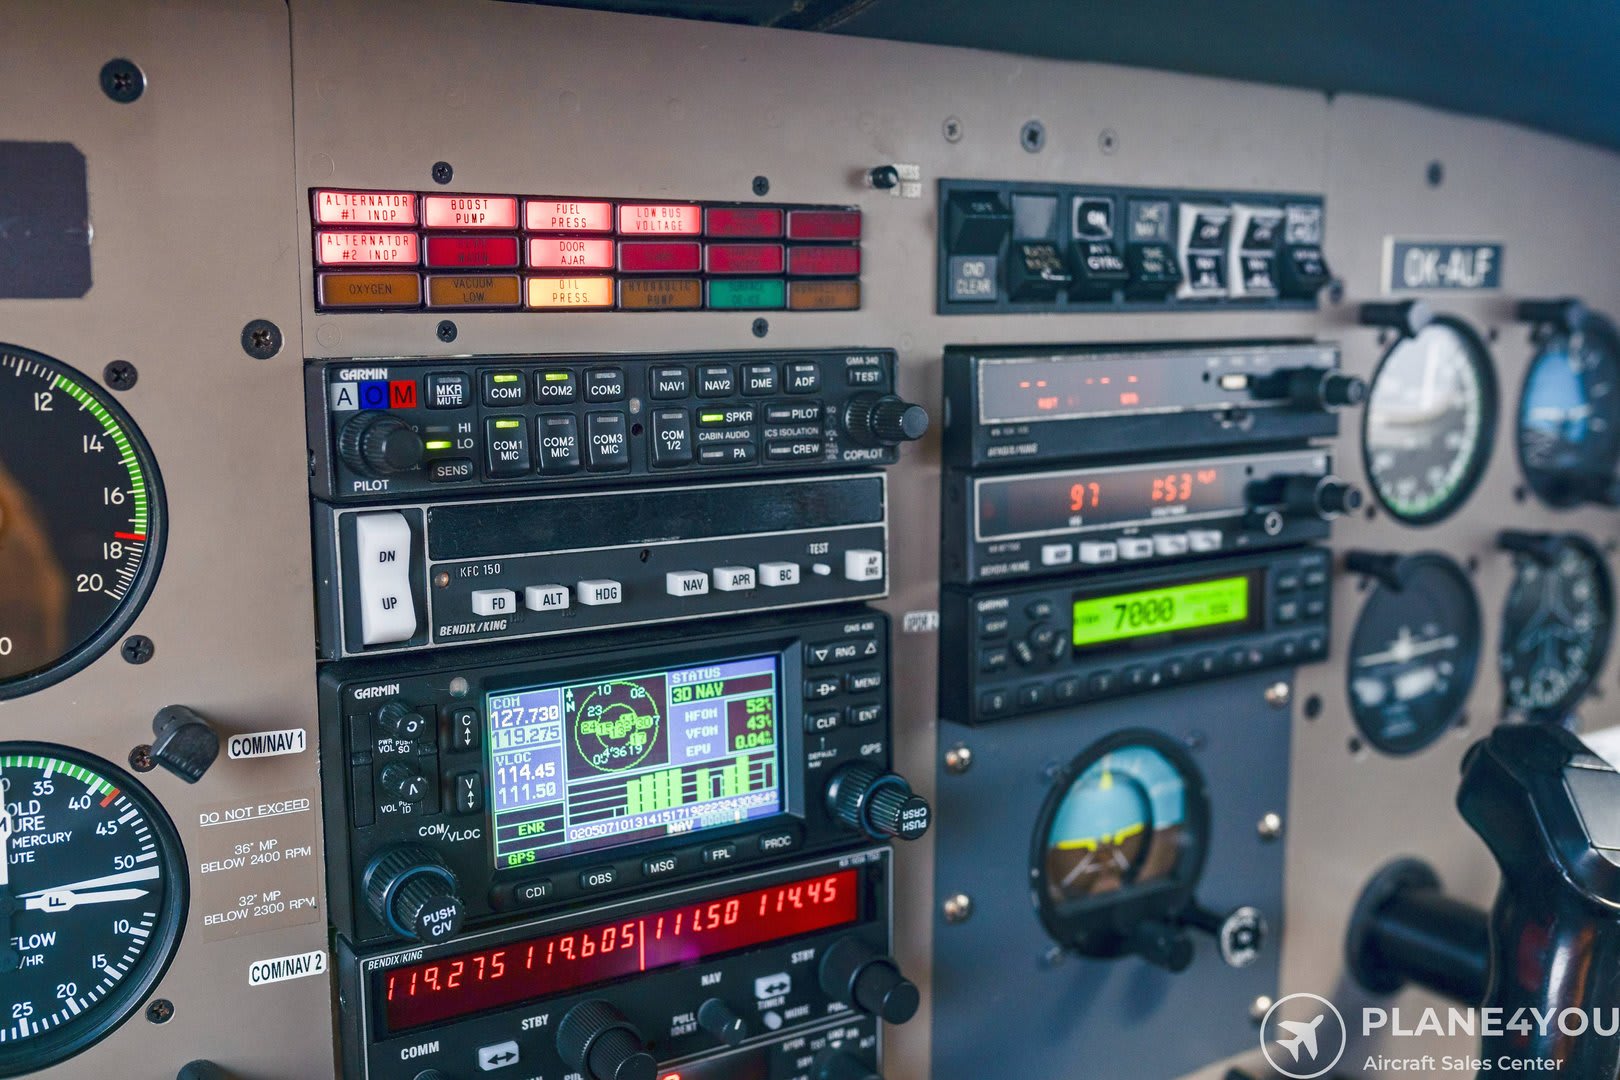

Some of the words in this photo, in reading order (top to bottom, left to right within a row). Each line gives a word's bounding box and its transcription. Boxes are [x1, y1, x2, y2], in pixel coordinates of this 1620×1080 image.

[326, 194, 408, 206] ALTERNATOR
[451, 199, 488, 210] BOOST
[341, 209, 356, 220] #1
[369, 210, 396, 221] INOP
[556, 204, 580, 214] FUEL
[637, 208, 657, 218] LOW
[662, 208, 681, 218] BUS
[456, 213, 485, 224] PUMP
[551, 216, 587, 228] PRESS
[636, 220, 683, 231] VOLTAGE
[327, 235, 409, 246] ALTERNATOR
[559, 241, 585, 252] DOOR
[342, 249, 357, 260] #2
[369, 250, 397, 260] INOP
[560, 254, 586, 265] AJAR
[349, 283, 392, 295] OXYGEN
[452, 278, 494, 289] VACUUM
[559, 279, 579, 290] OIL
[463, 291, 485, 303] LOW
[846, 356, 864, 365] GMA
[865, 355, 879, 364] 340
[339, 368, 388, 381] GARMIN
[854, 371, 879, 382] TEST
[659, 381, 685, 391] NAV1
[704, 380, 730, 391] NAV2
[751, 378, 773, 389] DME
[794, 376, 815, 386] ADF
[395, 385, 412, 404] M
[436, 384, 462, 395] MKR
[491, 387, 522, 399] COM1
[542, 385, 573, 396] COM2
[591, 384, 621, 396] COM3
[34, 392, 53, 411] 12
[436, 396, 462, 406] MUTE
[725, 411, 752, 423] SPKR
[791, 408, 819, 420] PILOT
[458, 423, 472, 433] HI
[779, 426, 819, 437] ISOLATION
[593, 435, 623, 445] COM3
[661, 430, 684, 440] COM
[698, 431, 724, 440] CABIN
[725, 429, 750, 439] AUDIO
[83, 435, 105, 454] 14
[457, 438, 474, 449] LO
[493, 441, 524, 451] COM1
[543, 437, 574, 447] COM2
[666, 440, 681, 451] 1/2
[550, 448, 570, 458] MIC
[600, 445, 619, 455] MIC
[732, 448, 746, 458] PA
[792, 443, 820, 454] CREW
[843, 448, 884, 460] COPILOT
[500, 450, 519, 461] MIC
[437, 465, 468, 477] SENS
[353, 480, 390, 492] PILOT
[104, 487, 125, 505] 16
[1070, 482, 1100, 512] 97
[103, 541, 123, 560] 18
[810, 543, 829, 554] TEST
[379, 550, 396, 562] DN
[460, 566, 479, 577] KFC
[483, 564, 501, 575] 150
[780, 570, 792, 581] BC
[76, 573, 104, 593] 20
[683, 579, 704, 592] NAV
[732, 574, 751, 586] APR
[543, 592, 563, 605] ALT
[595, 588, 618, 600] HDG
[382, 598, 397, 610] UP
[492, 598, 506, 610] FD
[1113, 597, 1174, 631] 7000
[439, 620, 507, 636] BENDIX/KING
[835, 646, 856, 658] RNG
[672, 667, 721, 684] STATUS
[854, 677, 881, 689] MENU
[354, 684, 400, 700] GARMIN
[672, 686, 692, 702] 3D
[696, 682, 724, 700] NAV
[462, 716, 471, 726] C
[492, 704, 559, 728] 127.730
[858, 709, 878, 722] ENT
[816, 718, 837, 729] CLR
[231, 731, 294, 757] COM/NAV
[297, 731, 303, 749] 1
[378, 744, 394, 754] VOL
[686, 742, 712, 758] EPU
[860, 742, 882, 756] GPS
[496, 752, 532, 766] VLOC
[498, 762, 556, 785] 114.45
[32, 780, 55, 796] 35
[499, 782, 556, 805] 111.50
[68, 794, 92, 810] 40
[200, 812, 220, 825] DO
[225, 806, 253, 820] NOT
[258, 798, 310, 815] EXCEED
[380, 804, 398, 814] VOL
[95, 820, 118, 836] 45
[418, 823, 481, 842] COM/VLOC
[518, 822, 546, 836] ENR
[12, 830, 73, 849] MERCURY
[260, 839, 278, 852] MP
[764, 835, 792, 850] PROC
[201, 856, 246, 874] BELOW
[250, 850, 281, 866] 2400
[285, 846, 312, 860] RPM
[508, 850, 536, 866] GPS
[712, 850, 731, 860] FPL
[114, 855, 135, 870] 50
[650, 860, 675, 874] MSG
[588, 872, 612, 886] OBS
[262, 890, 281, 902] MP
[525, 886, 546, 899] CDI
[204, 909, 250, 926] BELOW
[254, 902, 285, 918] 2300
[289, 897, 316, 910] RPM
[654, 899, 738, 940] 111.50
[757, 878, 837, 917] 114.45
[422, 905, 457, 926] PUSH
[114, 919, 130, 934] 10
[432, 921, 453, 936] C/V
[92, 954, 108, 970] 15
[368, 950, 424, 971] BENDIX/KING
[387, 951, 506, 1001] 119.275
[526, 922, 634, 971] 119.605
[252, 956, 312, 983] COM/NAV
[314, 953, 322, 970] 2
[701, 972, 722, 987] NAV
[56, 982, 78, 999] 20
[12, 1001, 34, 1019] 25
[521, 1014, 550, 1031] STBY
[672, 1012, 696, 1024] PULL
[400, 1040, 440, 1061] COMM
